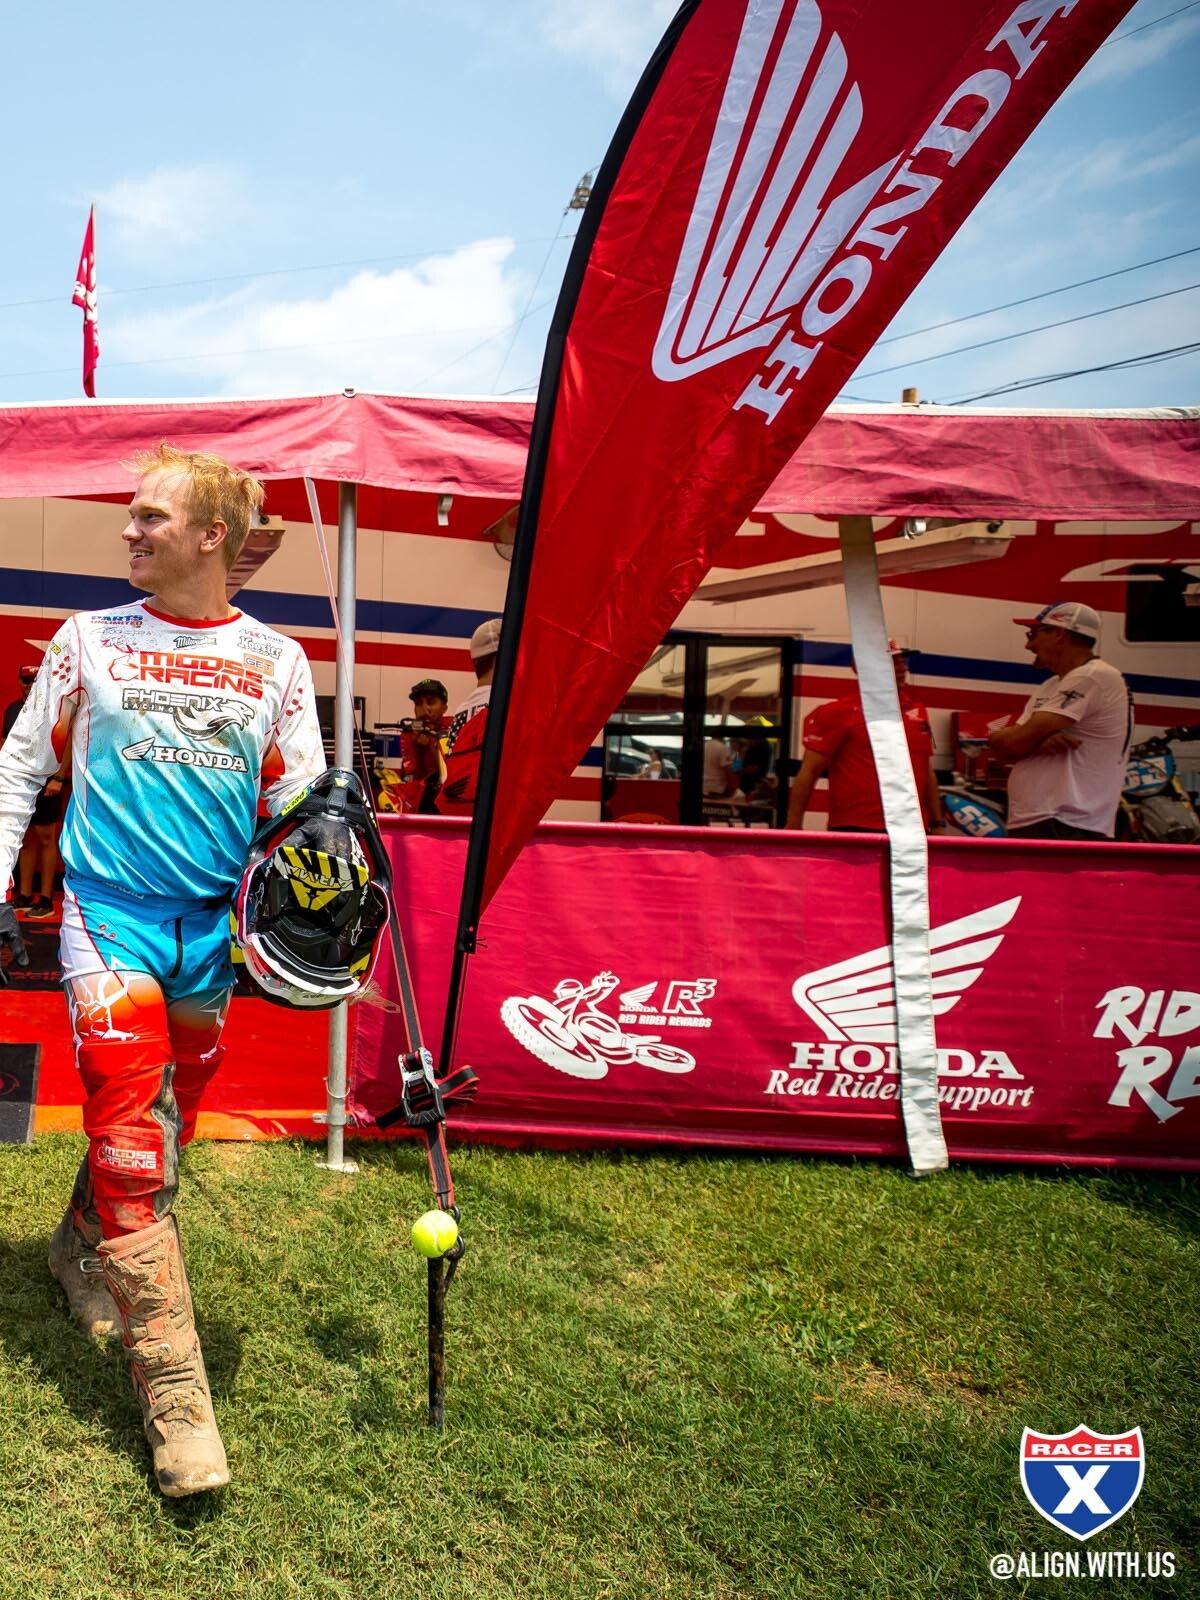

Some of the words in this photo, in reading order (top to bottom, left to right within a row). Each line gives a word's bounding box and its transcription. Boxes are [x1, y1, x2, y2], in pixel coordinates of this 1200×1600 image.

[732, 0, 1078, 426] HONDA
[140, 651, 263, 684] MOOSE
[245, 658, 272, 671] GET
[140, 666, 263, 700] RACING
[123, 689, 224, 711] PHOENIX
[123, 703, 175, 713] RACING
[151, 746, 249, 773] HONDA
[954, 805, 999, 836] 53
[618, 1013, 638, 1024] RED
[638, 1014, 667, 1026] RIDER
[667, 1016, 713, 1028] REWARDS
[619, 1004, 658, 1013] HONDA
[1092, 986, 1200, 1047] RID
[788, 1042, 1024, 1080] HODA
[764, 1069, 820, 1097] Red
[936, 1078, 1035, 1111] upport
[1107, 1045, 1200, 1124] RE
